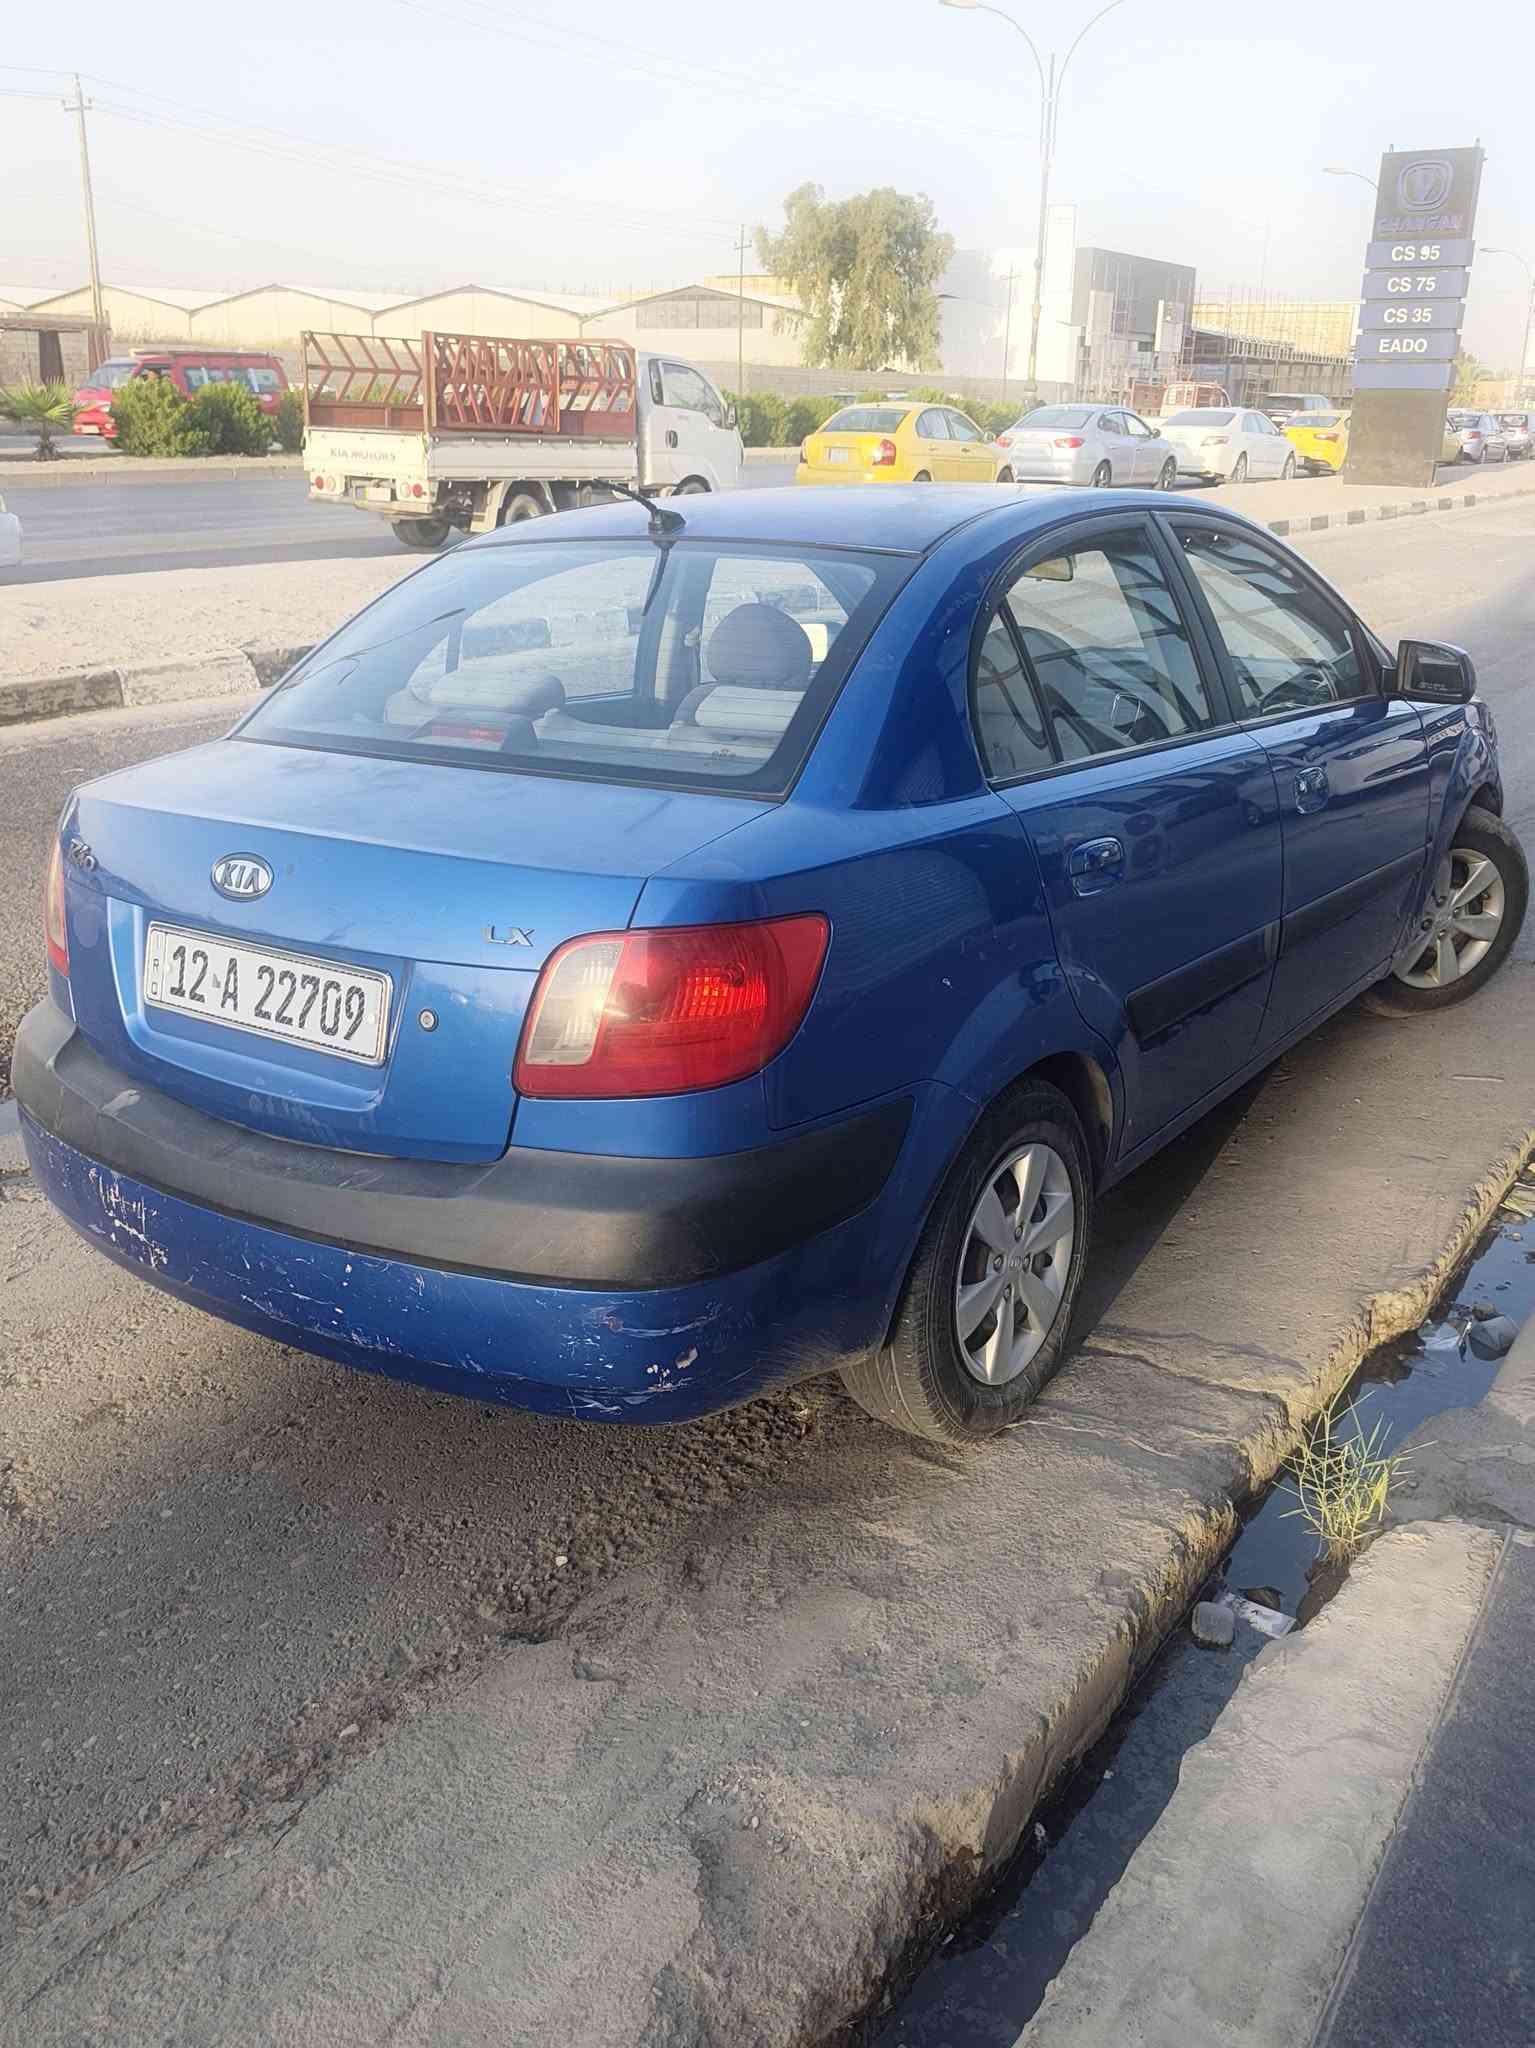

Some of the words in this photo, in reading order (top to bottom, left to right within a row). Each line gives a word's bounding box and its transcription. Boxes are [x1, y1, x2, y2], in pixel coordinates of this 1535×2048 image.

[1391, 246, 1416, 261] CS
[1420, 245, 1441, 261] 95
[1387, 277, 1412, 292] CS
[1416, 276, 1437, 292] 75
[1383, 307, 1408, 323] CS
[1411, 307, 1433, 323] 35
[1379, 338, 1428, 353] EADO
[330, 447, 348, 459] KIA
[221, 862, 261, 892] KIA
[483, 925, 535, 947] LX
[169, 945, 209, 1003] 12
[221, 957, 239, 1012] A
[254, 964, 365, 1041] 22709
